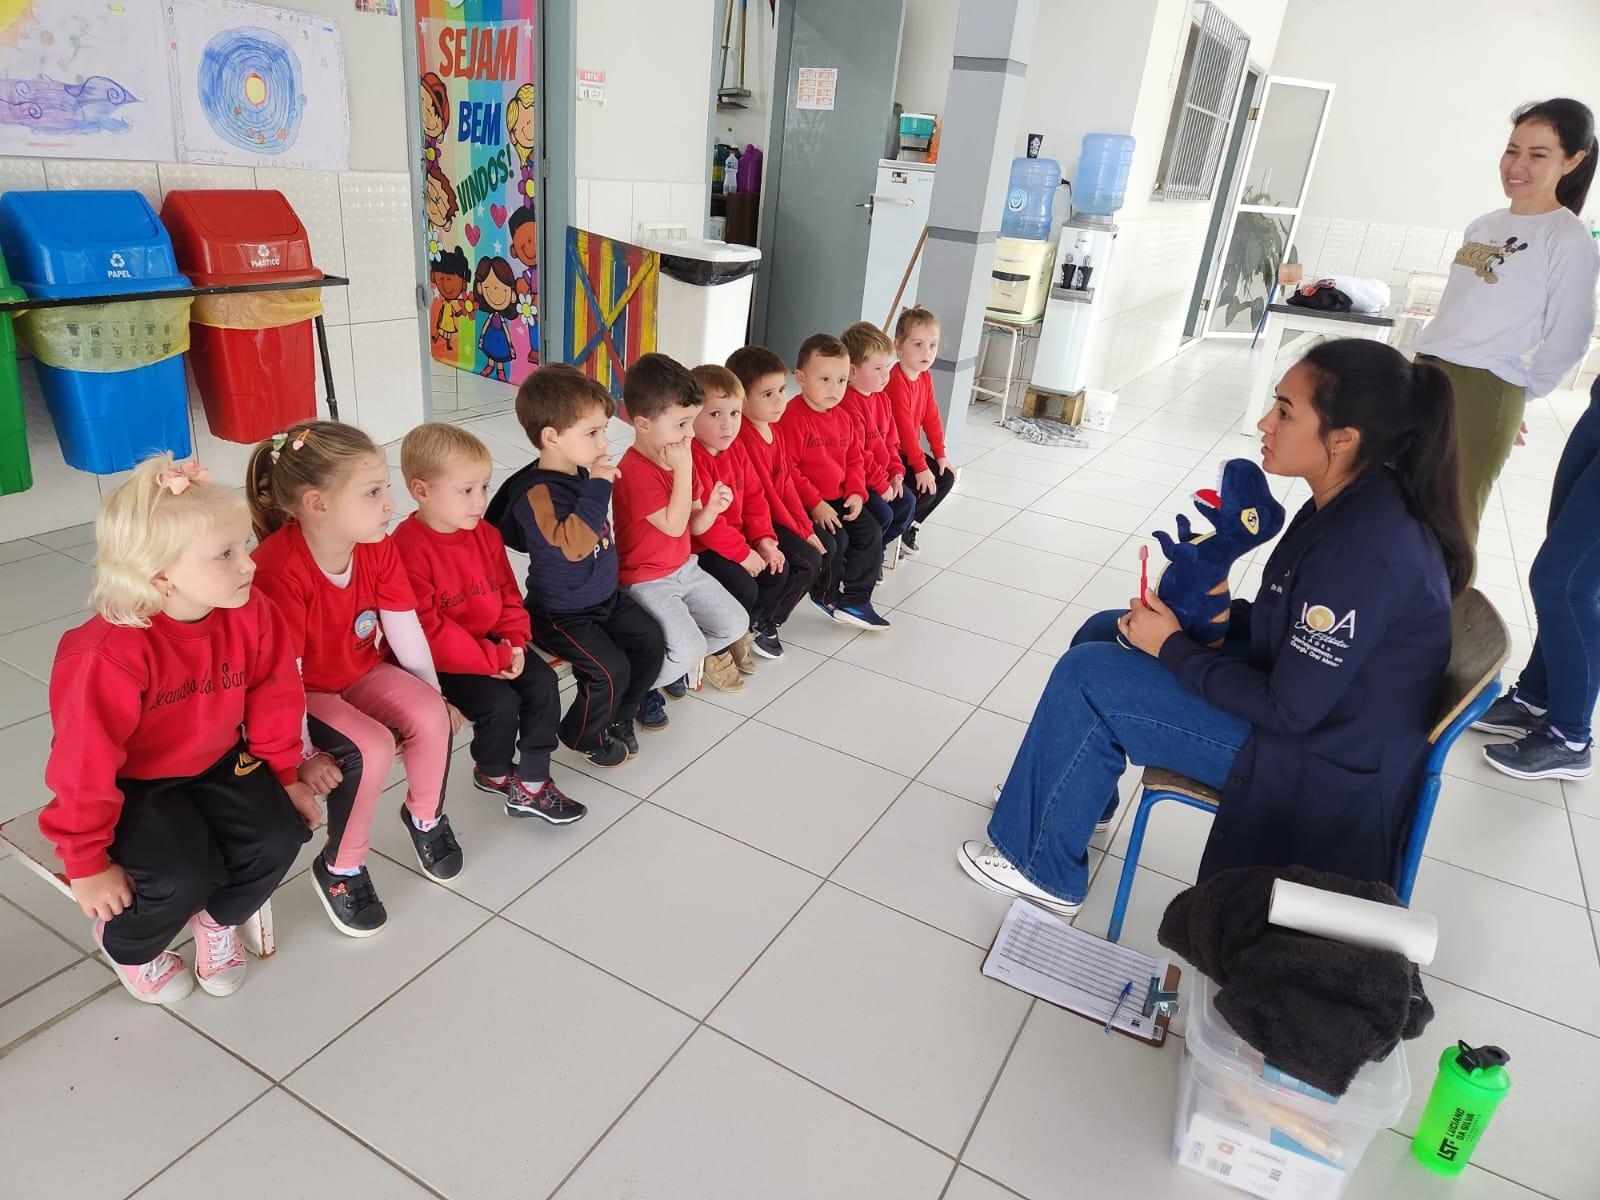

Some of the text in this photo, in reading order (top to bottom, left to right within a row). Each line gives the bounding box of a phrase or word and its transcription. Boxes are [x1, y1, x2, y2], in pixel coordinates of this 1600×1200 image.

[438, 25, 519, 82] SEJAM
[457, 100, 502, 146] BEM
[456, 143, 515, 216] VINDOS!
[107, 270, 132, 279] PAPEL
[1446, 1108, 1465, 1138] LUCIANO
[1456, 1130, 1466, 1141] DA
[1460, 1113, 1476, 1132] SILVA
